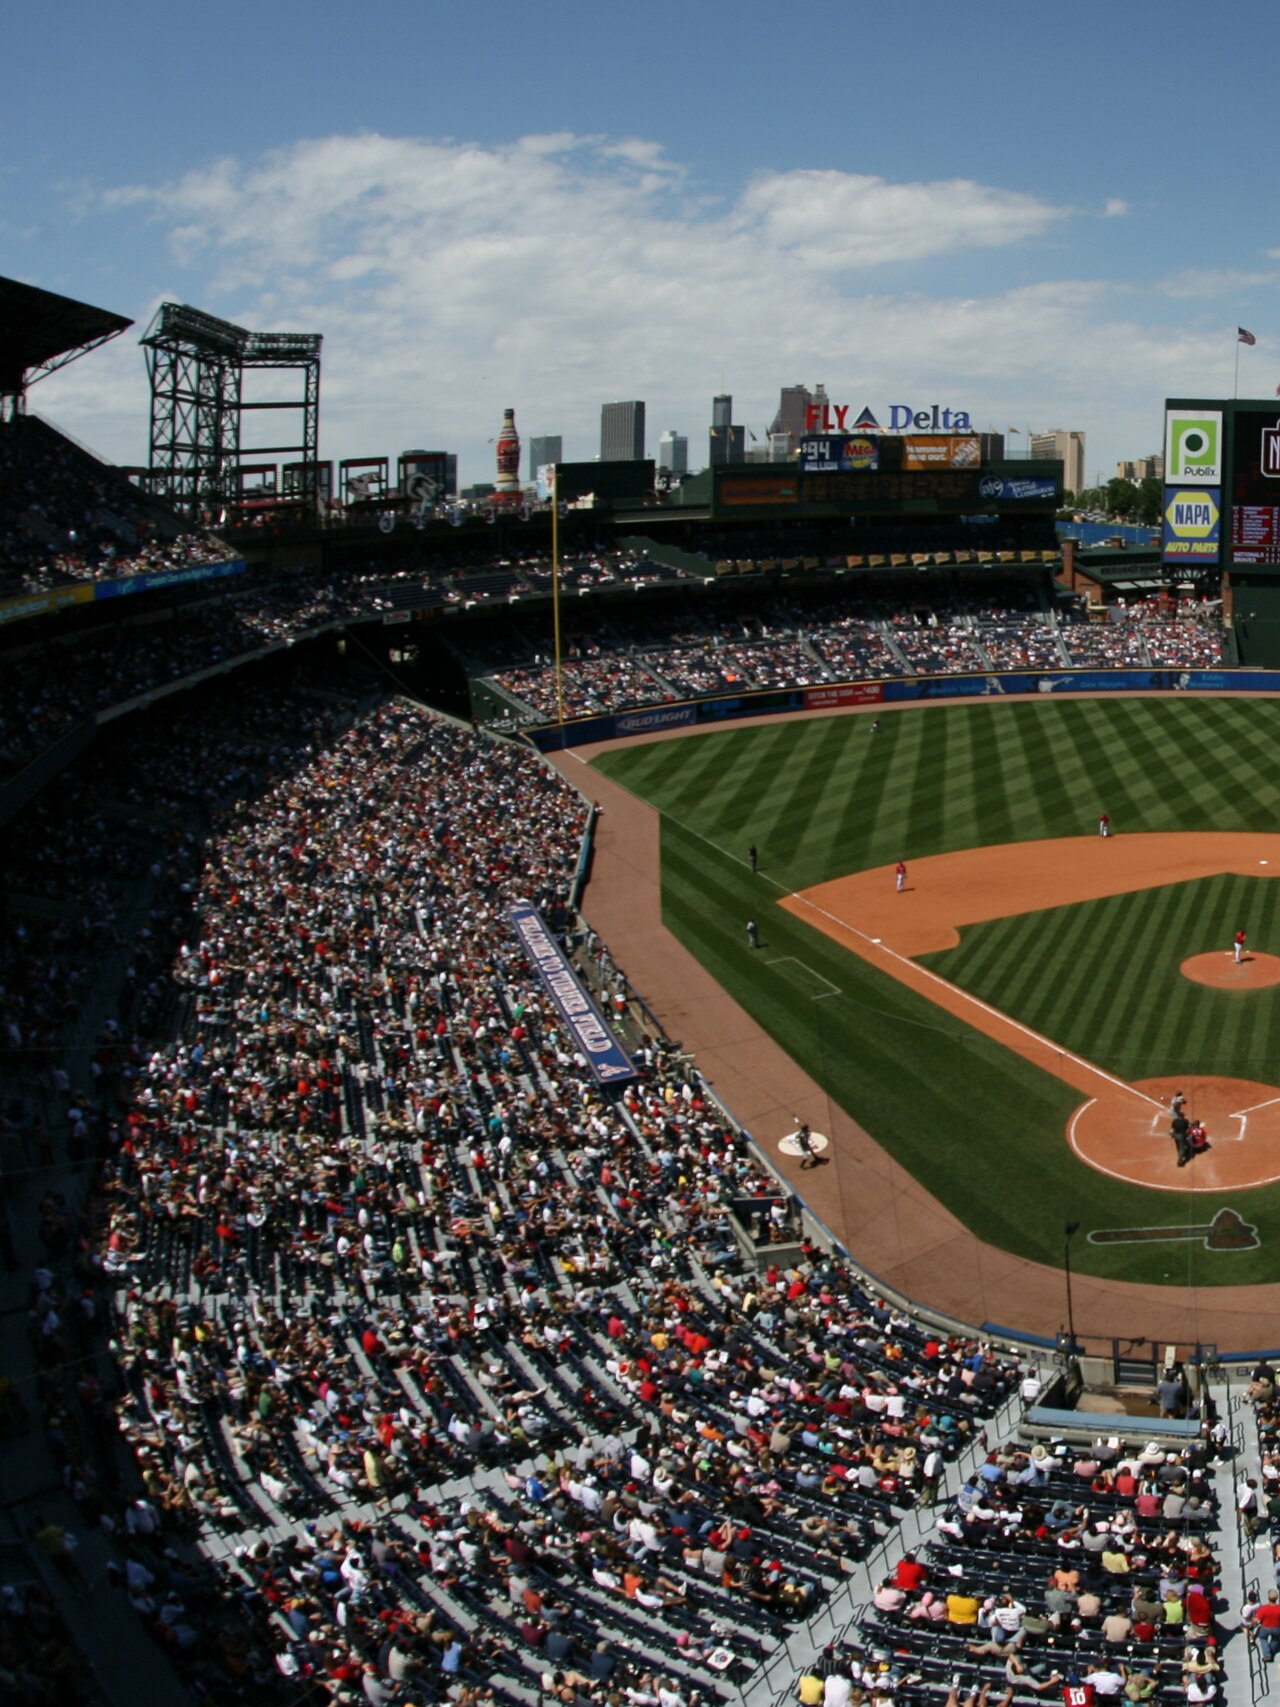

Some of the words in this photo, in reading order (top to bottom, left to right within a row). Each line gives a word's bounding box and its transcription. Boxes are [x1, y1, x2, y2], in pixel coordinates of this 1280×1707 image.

[805, 404, 849, 430] FLY
[889, 404, 972, 430] Delta
[802, 441, 830, 460] $94
[1184, 466, 1216, 476] Publix
[1175, 504, 1211, 525] NAPA
[1165, 542, 1189, 552] AUTO
[622, 715, 653, 730] BUD
[654, 709, 691, 723] LIGHT
[517, 915, 557, 959] WELCOME
[538, 956, 565, 973] TO
[547, 970, 590, 1015] TURNER
[569, 1012, 613, 1053] FIELD
[1070, 1692, 1086, 1706] 10
